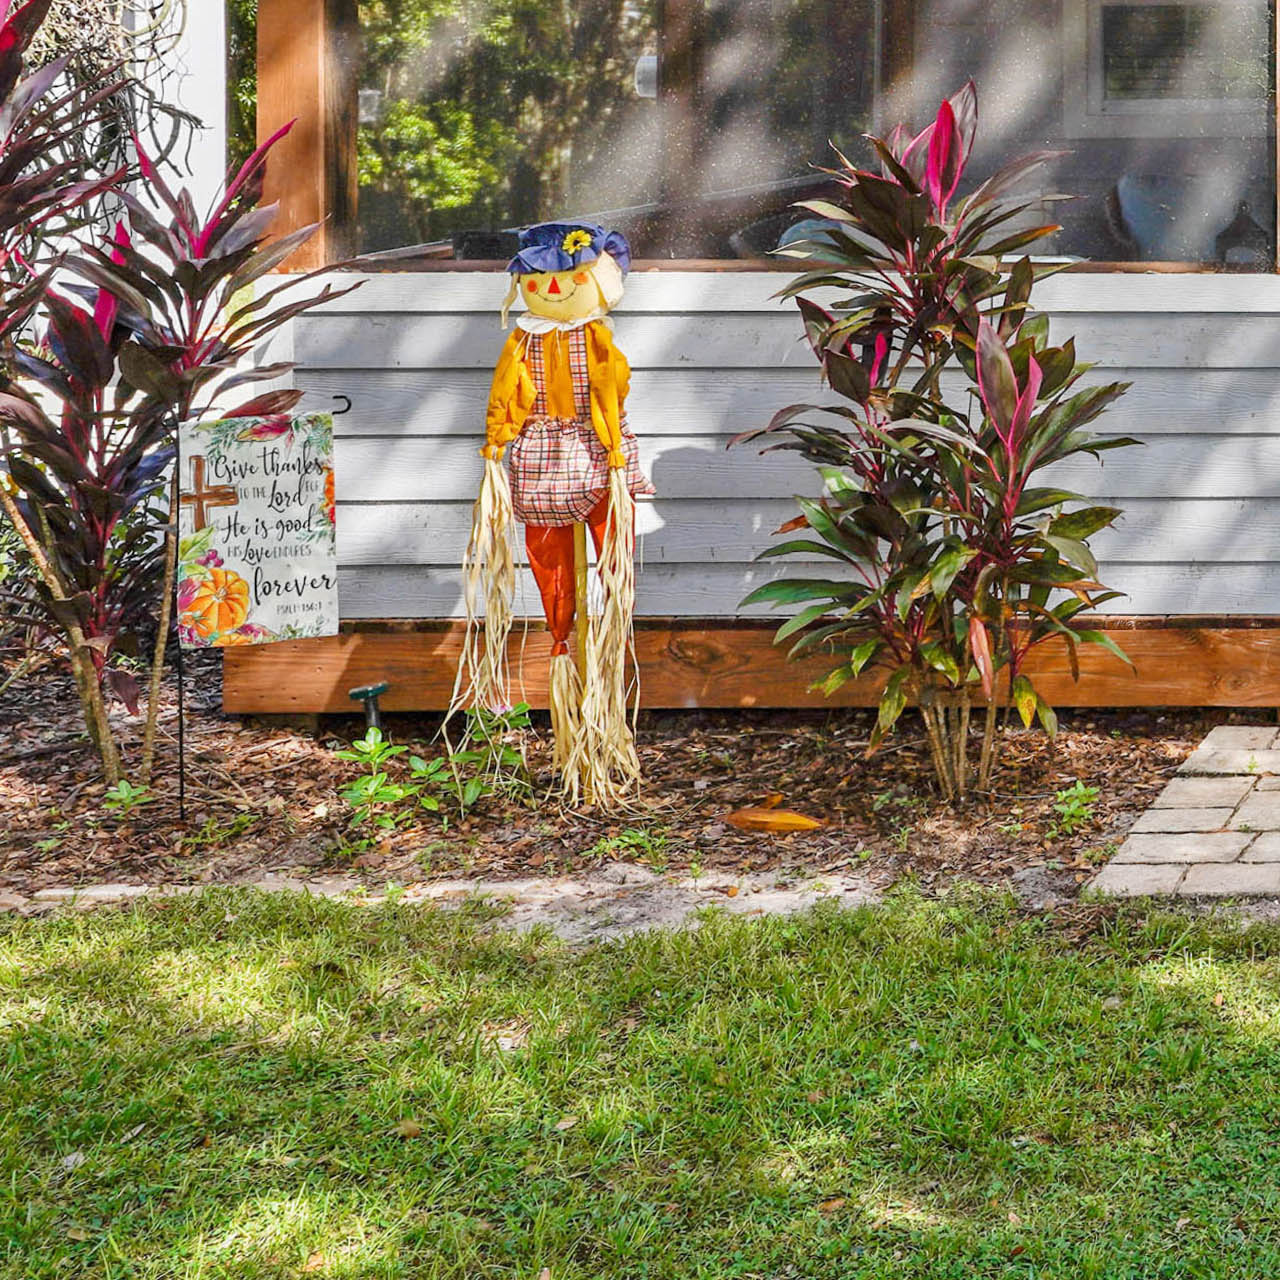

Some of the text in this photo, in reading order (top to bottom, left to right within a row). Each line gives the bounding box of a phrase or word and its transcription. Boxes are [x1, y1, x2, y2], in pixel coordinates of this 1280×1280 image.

[214, 439, 323, 483] Give thanks
[267, 474, 306, 513] Lord
[221, 504, 315, 544] He is good
[241, 538, 272, 566] Love
[254, 566, 338, 606] forever
